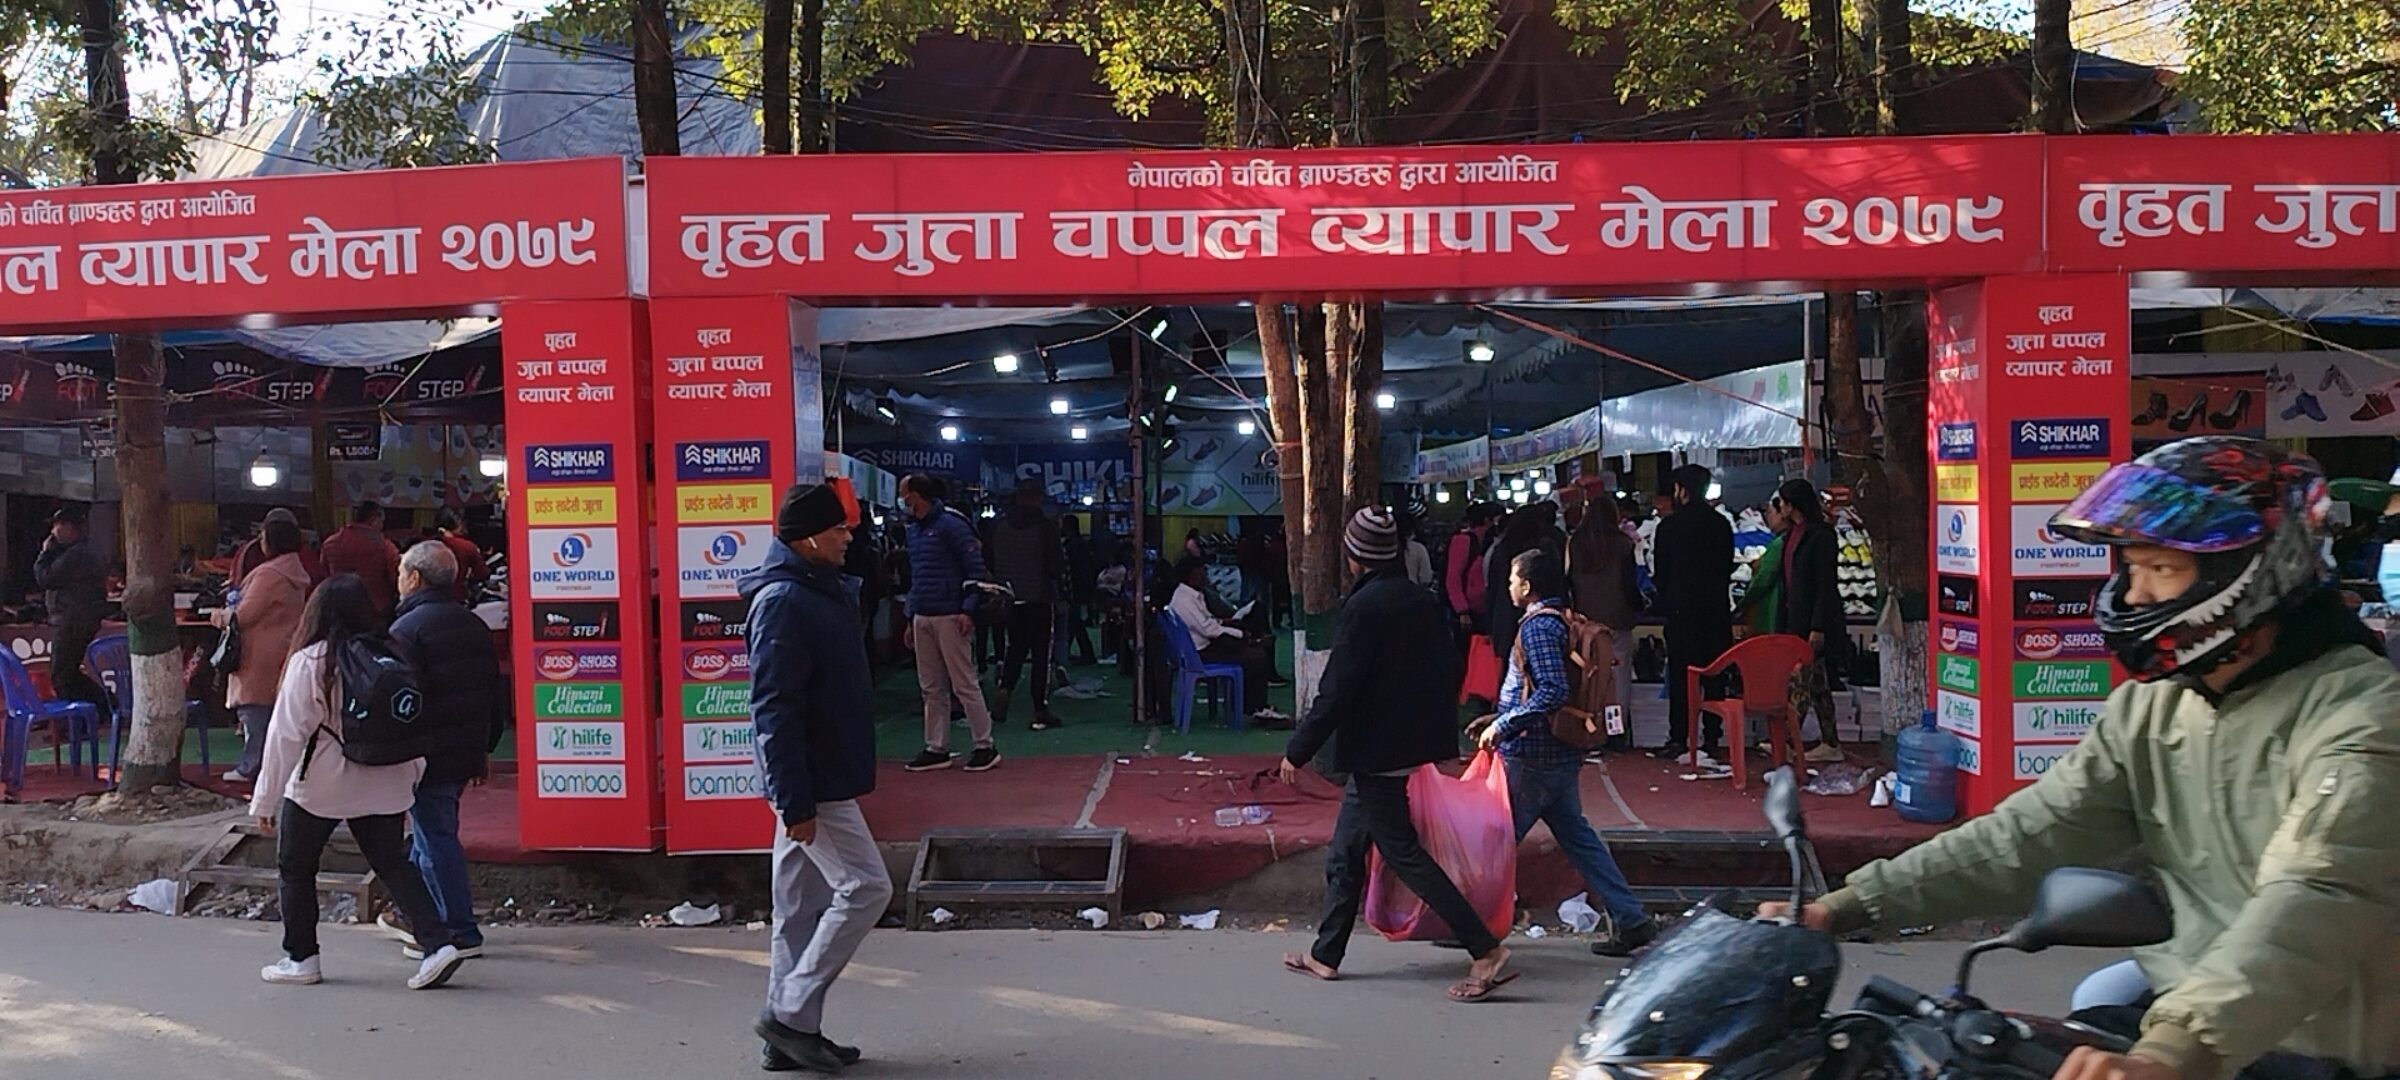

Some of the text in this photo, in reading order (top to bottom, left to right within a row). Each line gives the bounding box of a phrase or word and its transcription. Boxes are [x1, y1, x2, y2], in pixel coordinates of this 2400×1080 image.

[1128, 160, 1224, 188] नेपालको
[1231, 158, 1292, 187] चर्चित
[1400, 163, 1448, 191] द्वारा
[1455, 154, 1559, 183] आयोजित
[21, 199, 64, 225] चर्चित
[141, 198, 175, 226] द्वारा
[180, 190, 256, 218] आयोजित
[2078, 184, 2400, 249] वृहत जुत्त
[681, 185, 2004, 278] वृहत जुत्ता चप्पल व्यापार मेला २०७९
[79, 234, 271, 287] व्यापार
[289, 216, 422, 280] मेला
[440, 218, 597, 269] २०७९
[2038, 305, 2074, 325] वृहत
[544, 332, 576, 352] वृहत
[697, 328, 731, 348] वृहत
[2051, 332, 2106, 348] चप्पल
[557, 359, 607, 375] चप्पल
[711, 355, 764, 371] चप्पल
[2005, 356, 2112, 377] व्यापार मेला
[268, 382, 315, 401] STEP
[418, 380, 465, 399] STEP
[518, 382, 614, 403] व्यापार मेला
[668, 379, 772, 399] व्यापार मेला
[2038, 425, 2100, 443] SHIKHAR
[551, 450, 605, 468] SHIKHAR
[702, 447, 761, 465] SHIKHAR
[881, 450, 954, 469] SHIKHAR
[2015, 546, 2107, 560] ONE WORLD
[533, 570, 615, 583] ONE WORLD
[682, 570, 712, 581] ONE
[2058, 602, 2088, 615] STEP
[573, 625, 600, 637] STEP
[724, 624, 746, 636] STE
[2023, 633, 2106, 648] BOSS SHOES
[543, 654, 617, 669] BOSS SHOES
[693, 654, 725, 669] BOSS
[2035, 665, 2091, 684] Himani
[554, 686, 604, 703] Himani
[703, 686, 750, 703] Himan
[2026, 678, 2098, 695] Collection
[547, 699, 612, 715] Collection
[695, 699, 751, 715] Collecti
[2054, 708, 2098, 726] hilife
[572, 728, 613, 746] hilife
[722, 729, 753, 745] hilif
[541, 769, 622, 794] bamboo
